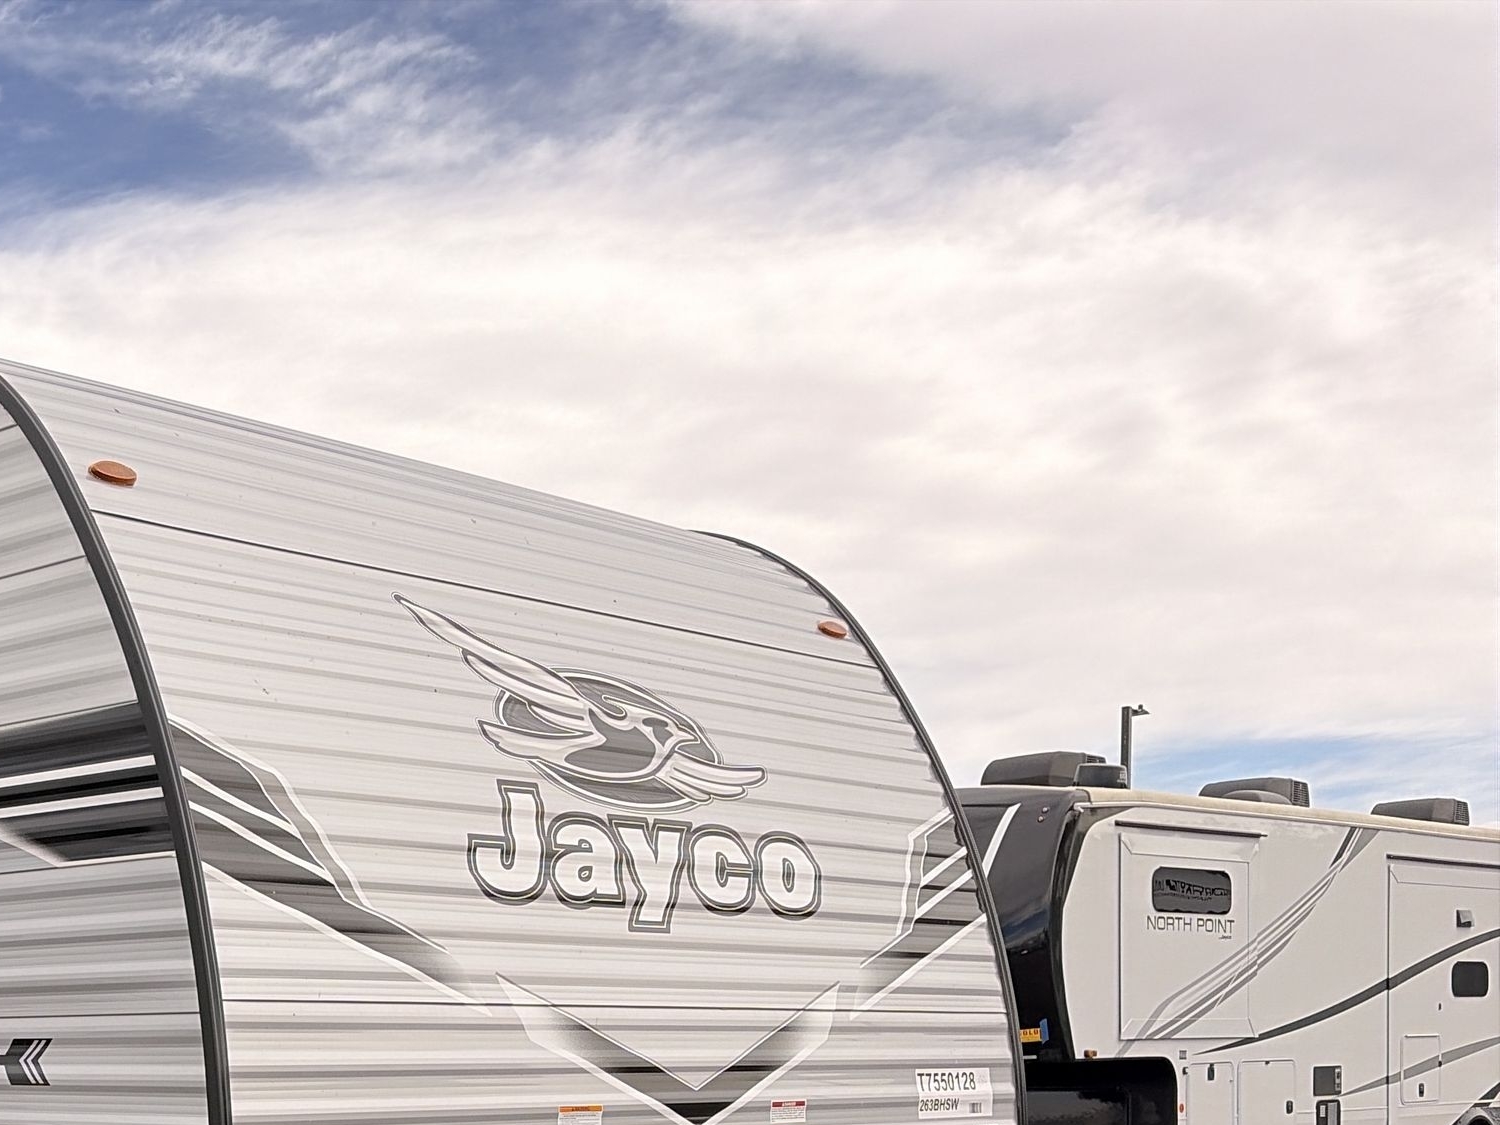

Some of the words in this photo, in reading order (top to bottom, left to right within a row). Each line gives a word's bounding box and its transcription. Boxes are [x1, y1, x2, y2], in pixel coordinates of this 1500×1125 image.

[467, 779, 821, 933] Jayco
[1146, 915, 1192, 931] NORTH
[1196, 917, 1235, 933] POINT
[917, 1072, 976, 1091] T7550128
[920, 1098, 959, 1112] 263BHSW
